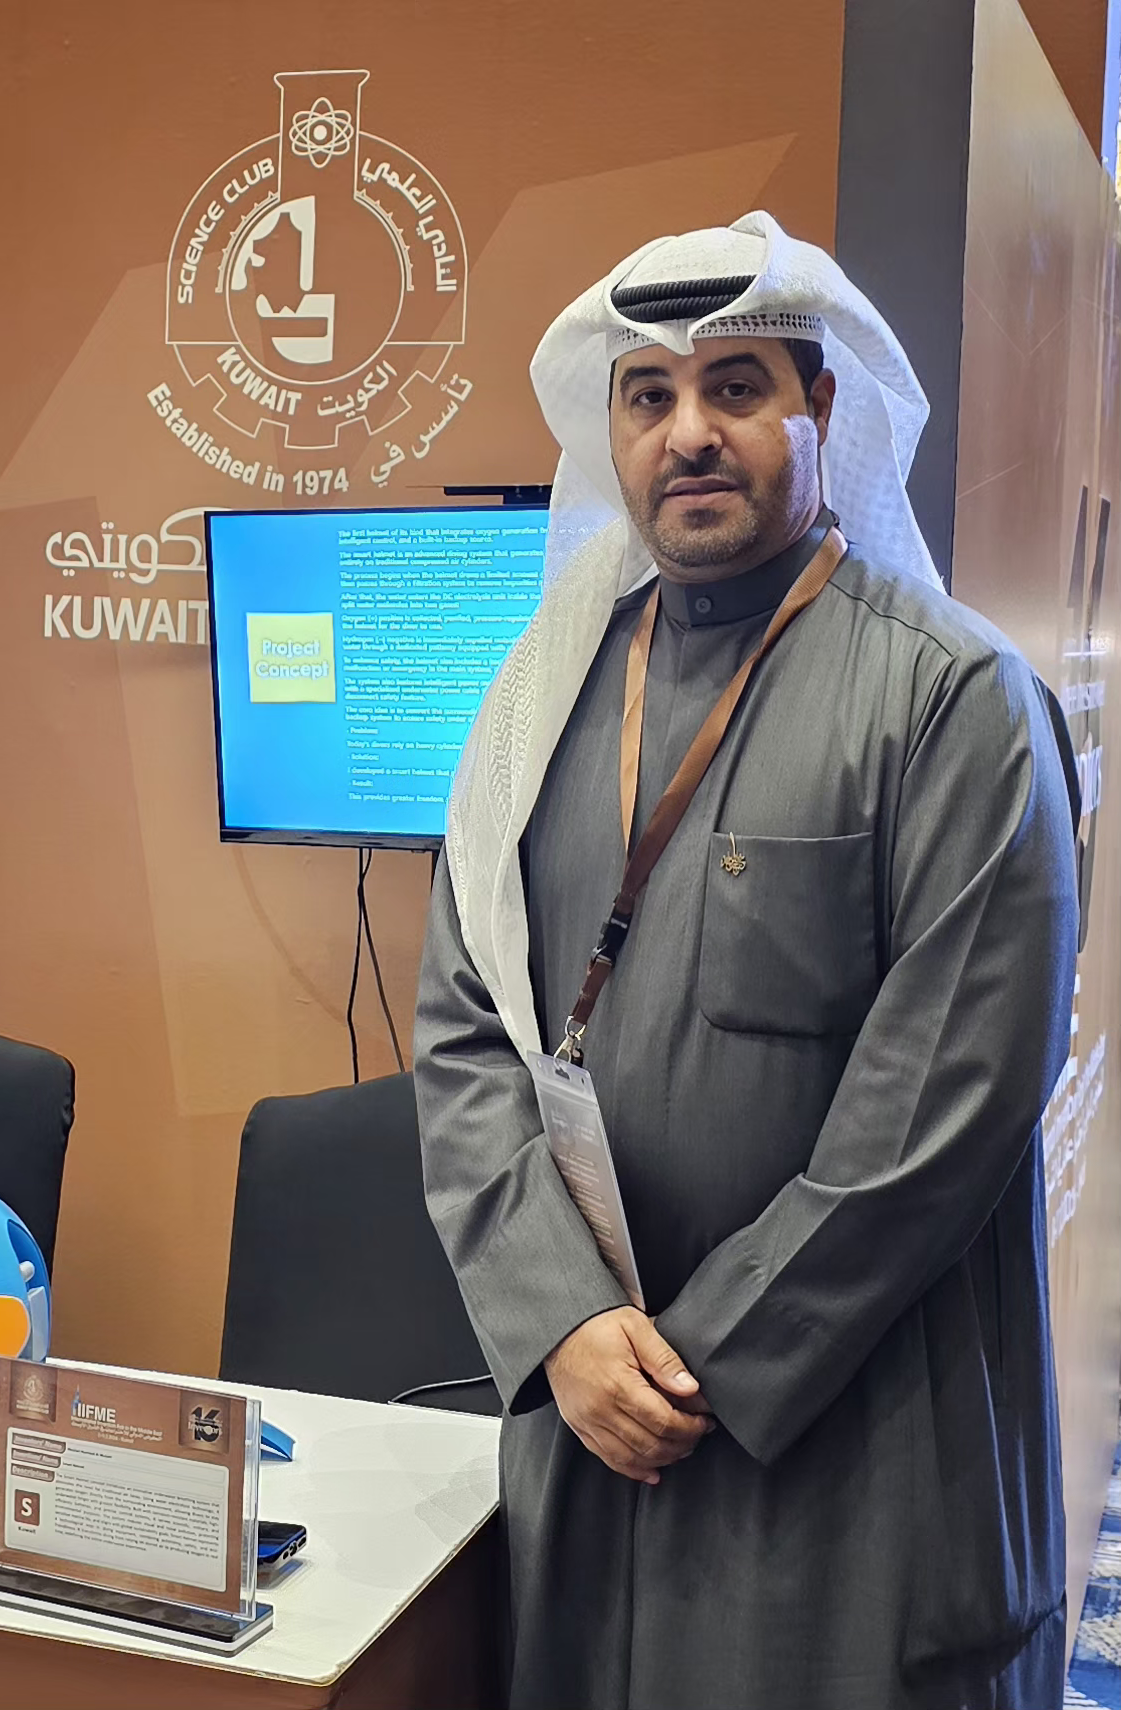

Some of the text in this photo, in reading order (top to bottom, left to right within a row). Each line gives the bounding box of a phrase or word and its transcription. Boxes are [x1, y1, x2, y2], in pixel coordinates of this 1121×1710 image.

[178, 157, 275, 304] SCIENCE CLUB
[216, 346, 302, 416] KUWAIT
[316, 360, 397, 418] الكويت
[146, 382, 349, 495] Established in 1974
[255, 661, 329, 680] Concept
[262, 639, 320, 660] Project
[21, 1497, 32, 1517] S
